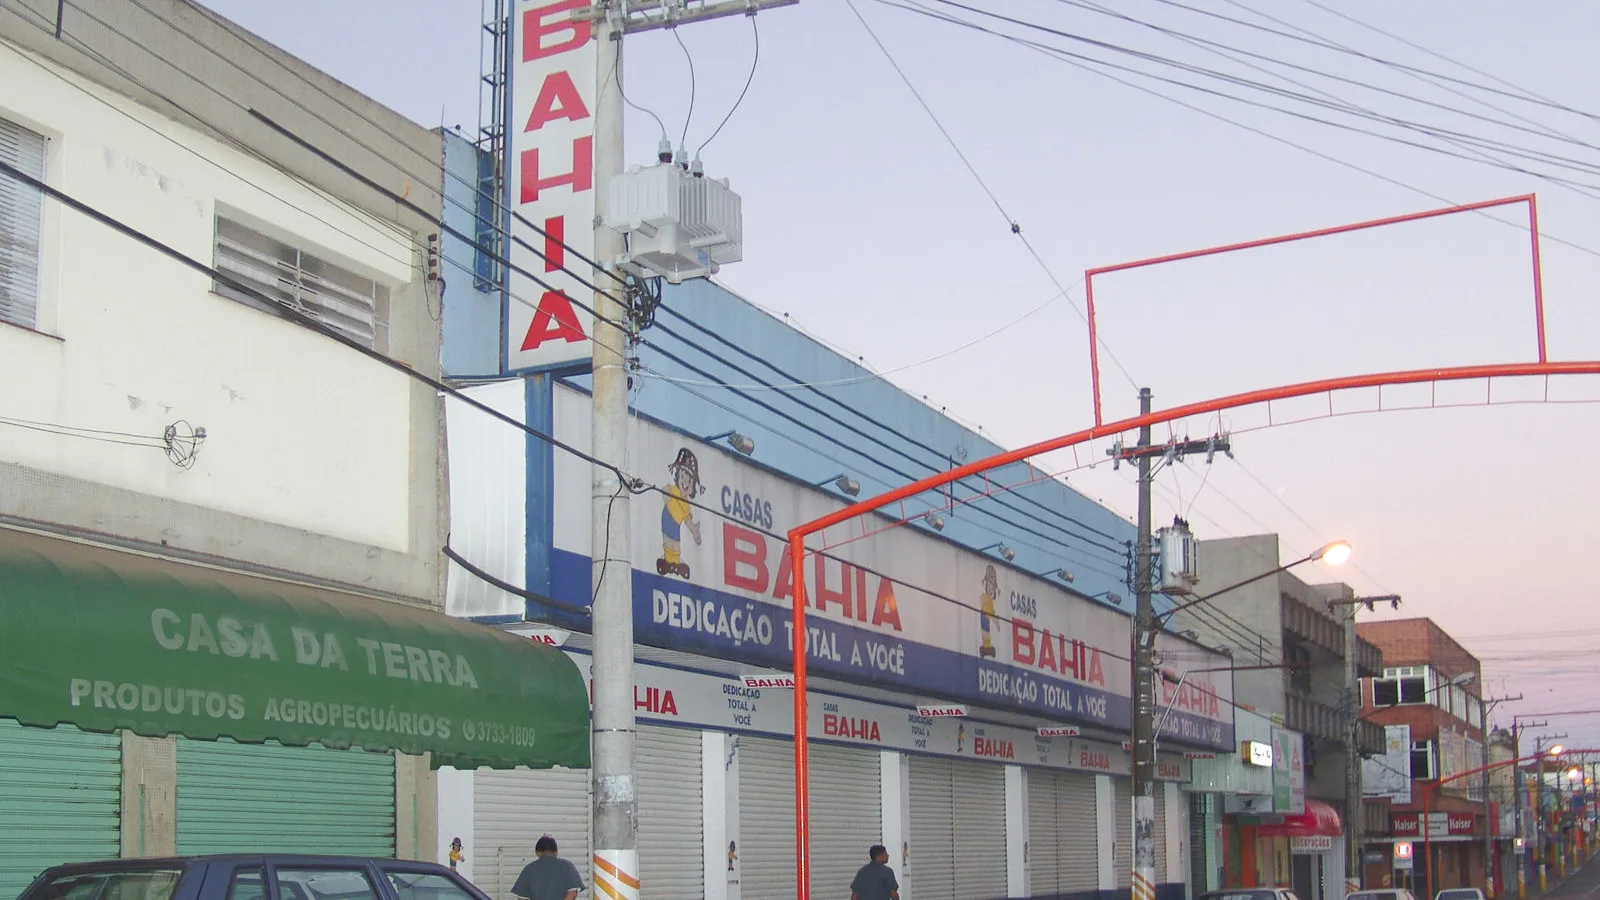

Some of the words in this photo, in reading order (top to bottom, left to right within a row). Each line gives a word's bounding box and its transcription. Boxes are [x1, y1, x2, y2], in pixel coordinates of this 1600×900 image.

[521, 0, 592, 352] BAHIA
[721, 485, 773, 530] CASAS
[1010, 590, 1037, 619] CASAS
[652, 589, 773, 646] DEDICAÇÃO
[784, 620, 841, 662] TTAL
[850, 640, 863, 667] A
[866, 640, 905, 675] VOCÊ
[151, 607, 279, 662] CASA
[294, 625, 349, 671] DA
[357, 636, 479, 689] TERRA
[1011, 617, 1105, 687] BAHIA
[745, 679, 795, 688] BAHIA
[978, 665, 1037, 705] DEDICAÇÃO
[1043, 682, 1072, 712] TOTAL
[1076, 695, 1084, 714] A
[1085, 695, 1106, 720] VOCÊ
[70, 678, 245, 720] PRODUTOS
[264, 699, 451, 740] AGROPECUÁRIOS
[477, 722, 536, 748] 3733-1809
[728, 698, 748, 711] TOTAL
[751, 703, 757, 712] A
[920, 708, 964, 716] BAHIA
[823, 713, 881, 741] BAHIA
[974, 736, 1016, 760] BAHIA
[1081, 751, 1109, 769] BAHIA
[1394, 819, 1418, 831] Kaiser
[1449, 817, 1473, 830] Kaiser
